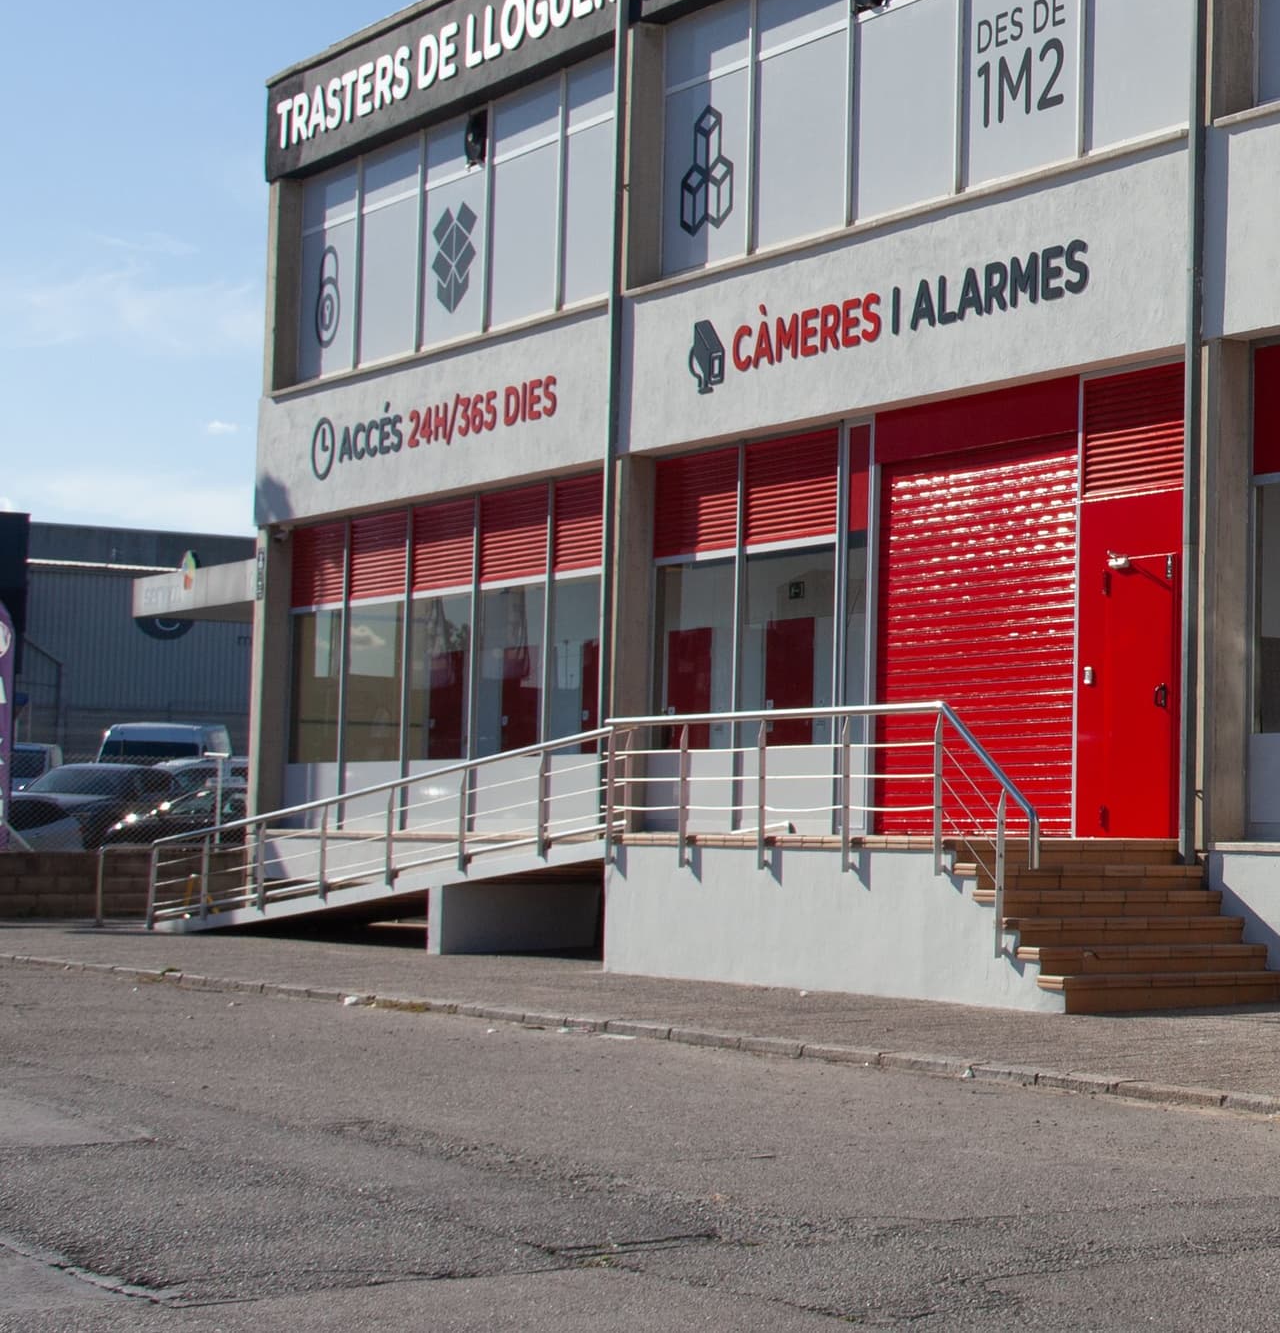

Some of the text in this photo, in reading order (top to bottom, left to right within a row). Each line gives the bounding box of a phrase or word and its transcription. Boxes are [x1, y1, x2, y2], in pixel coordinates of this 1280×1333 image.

[977, 6, 1024, 55] DES
[276, 45, 411, 150] TRASTERS
[417, 21, 459, 90] DE
[977, 37, 1065, 129] 1M2
[732, 238, 1090, 372] CÀMERES I ALARMES
[338, 375, 557, 463] ACCÉS 24H/365 DIES
